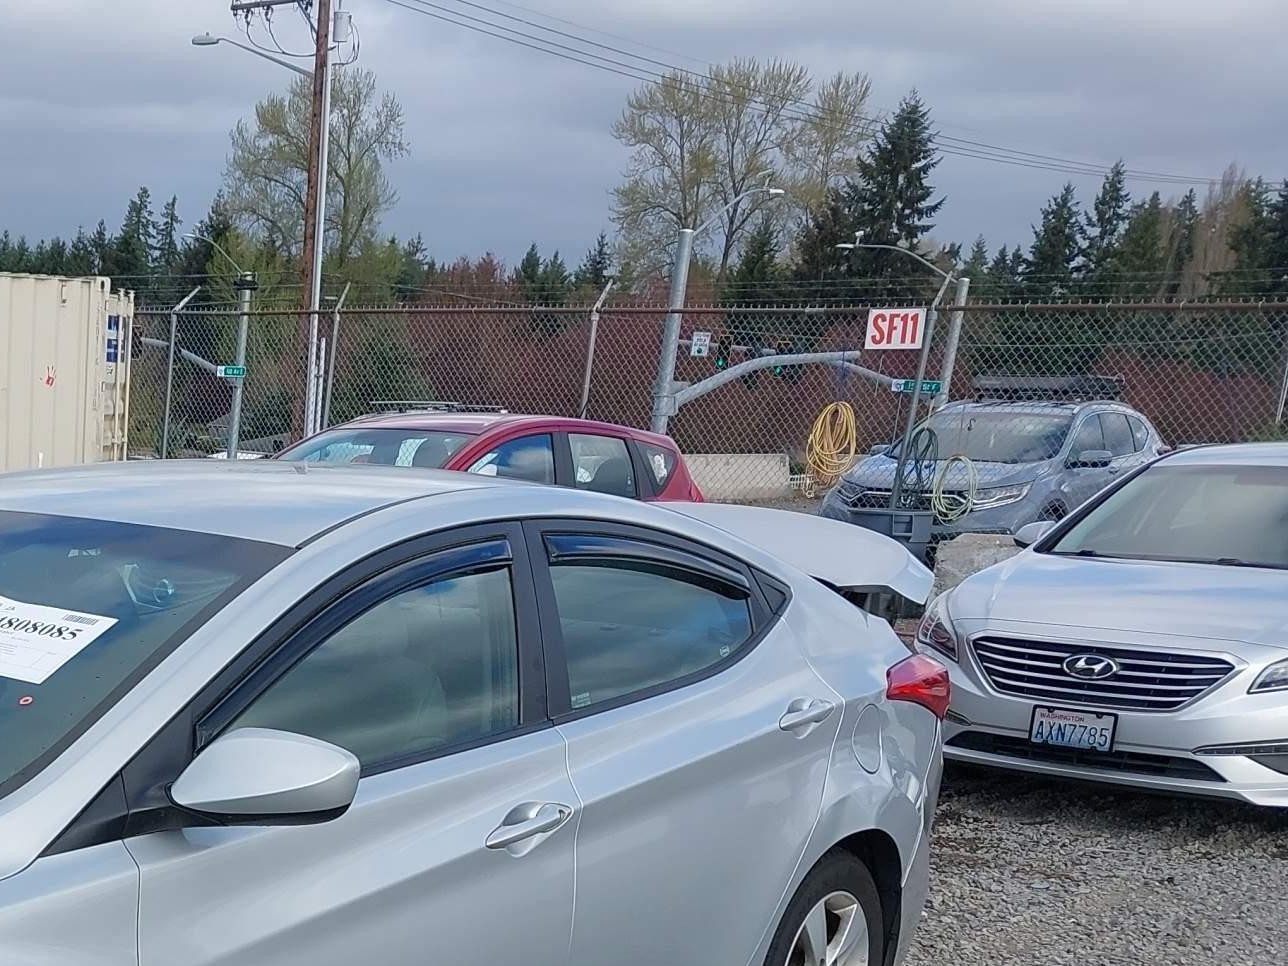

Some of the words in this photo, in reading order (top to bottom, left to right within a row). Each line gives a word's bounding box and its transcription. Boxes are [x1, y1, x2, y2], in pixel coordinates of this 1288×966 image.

[871, 313, 919, 345] SF11
[1040, 711, 1085, 722] WASHINGTON
[1035, 720, 1110, 747] AXN7785
